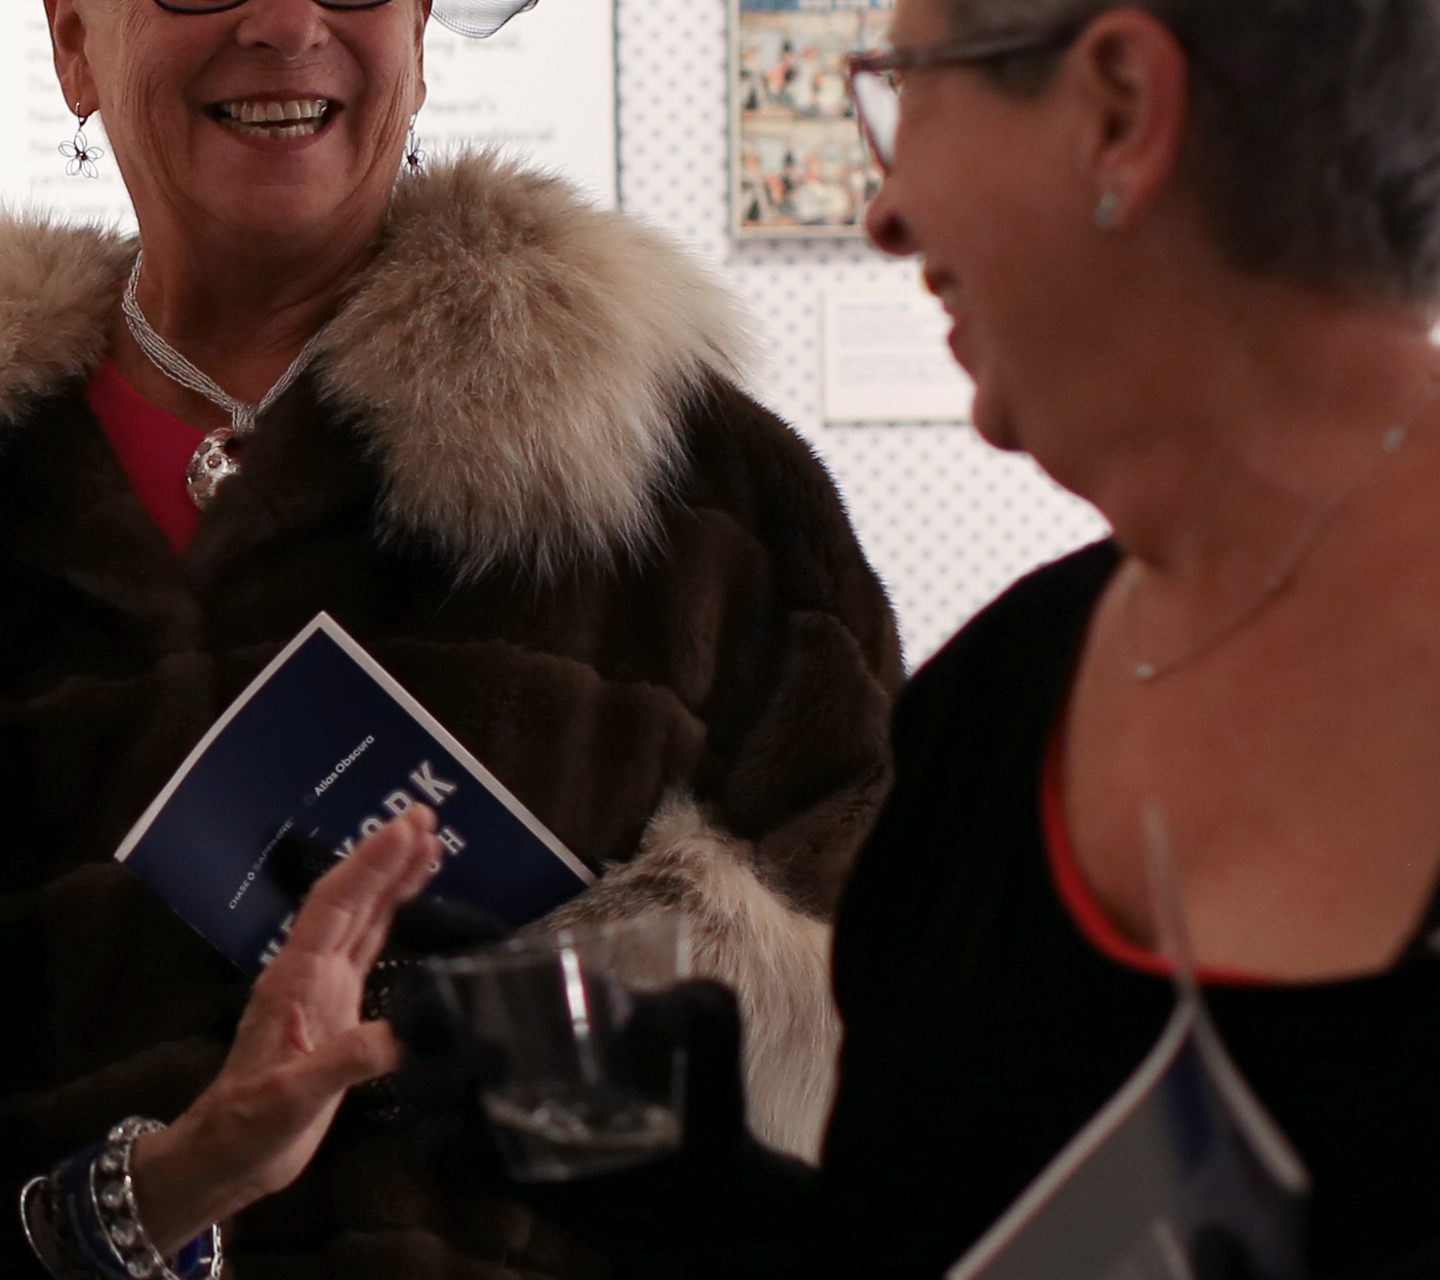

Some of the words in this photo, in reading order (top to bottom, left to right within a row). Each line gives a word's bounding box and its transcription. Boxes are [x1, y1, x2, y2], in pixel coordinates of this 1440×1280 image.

[314, 771, 338, 797] Atlas
[335, 734, 376, 774] Obscura
[228, 879, 251, 910] CHASE
